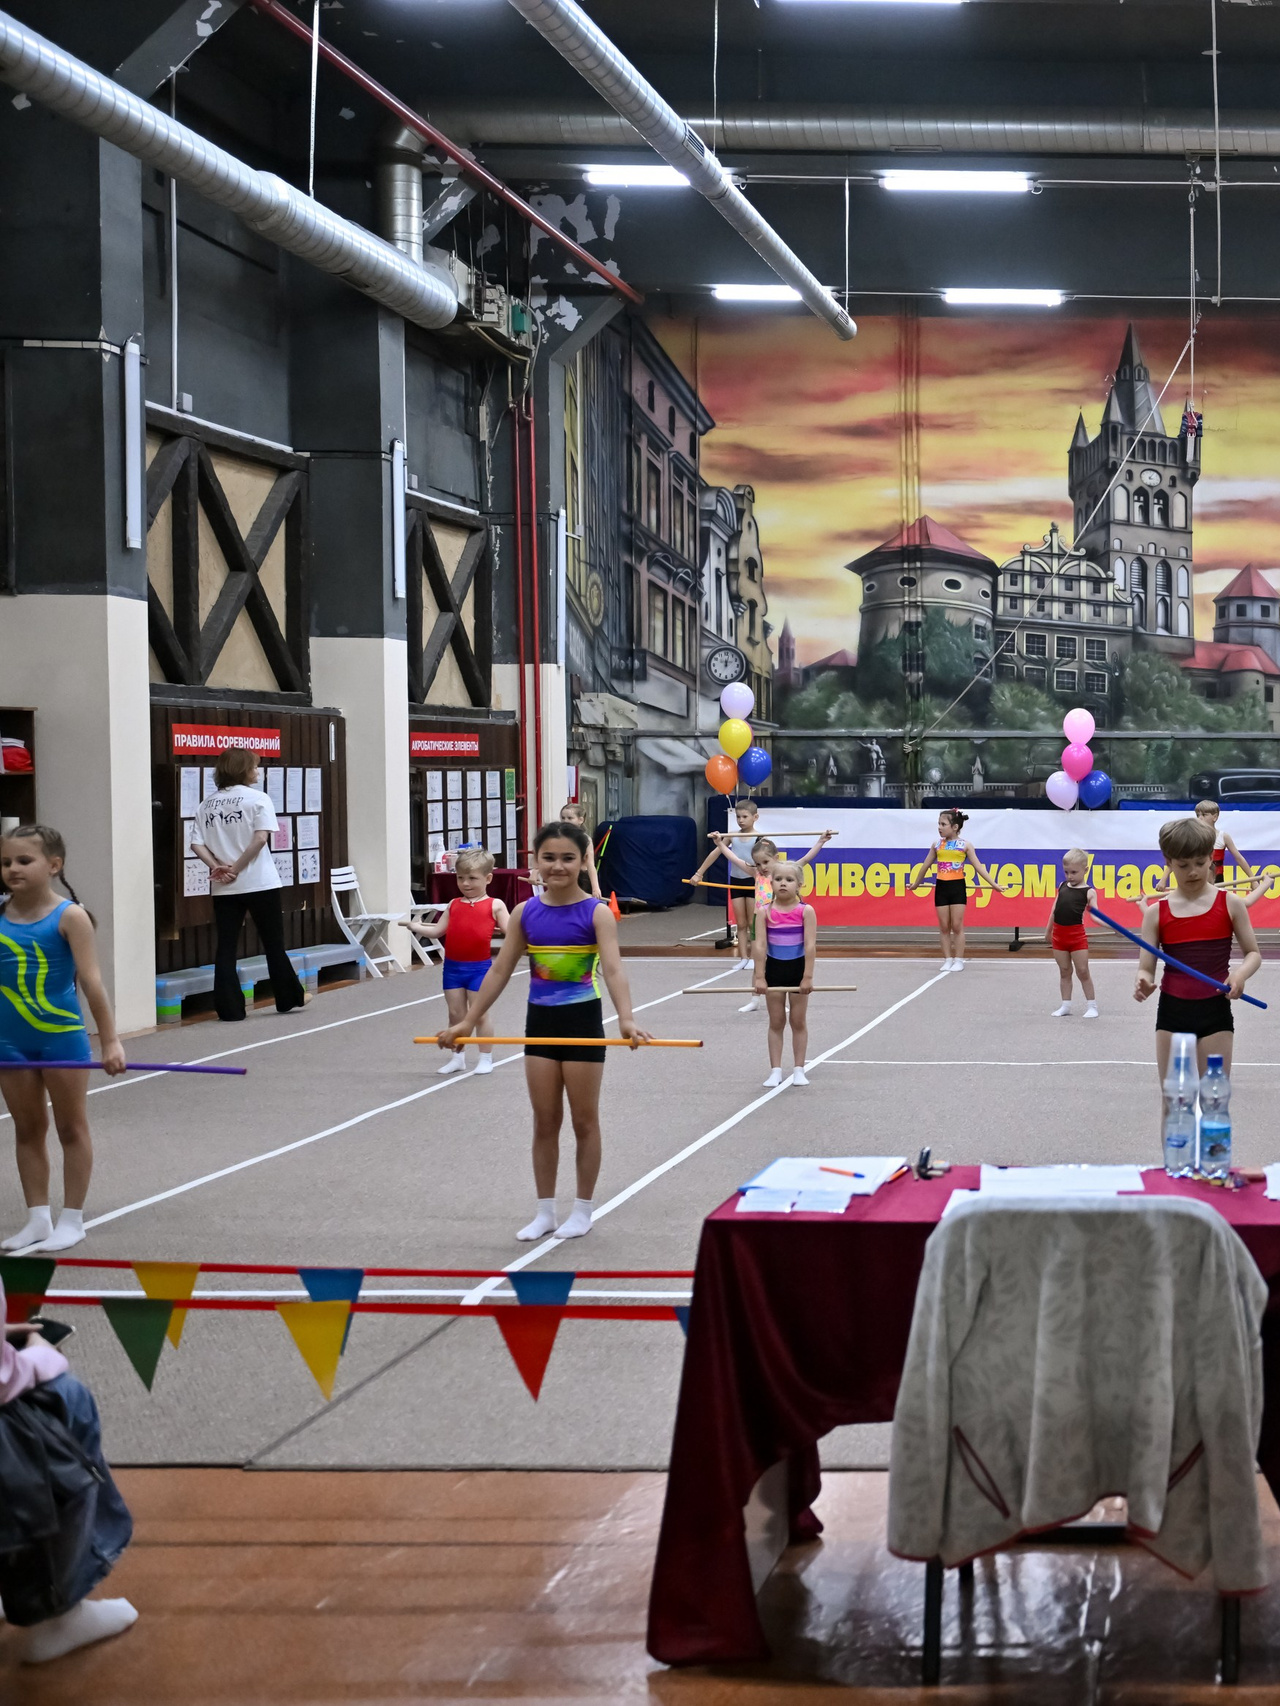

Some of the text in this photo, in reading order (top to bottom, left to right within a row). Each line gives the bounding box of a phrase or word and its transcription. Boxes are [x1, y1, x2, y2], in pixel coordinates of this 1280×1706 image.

[174, 733, 281, 751] ПРАВИЛА СОРЕВНОВАНИЙ
[411, 740, 479, 751] АКРОБАТИЧЕСКИЕ ЭЛЕМЕНТЫ
[204, 796, 244, 810] Тренер
